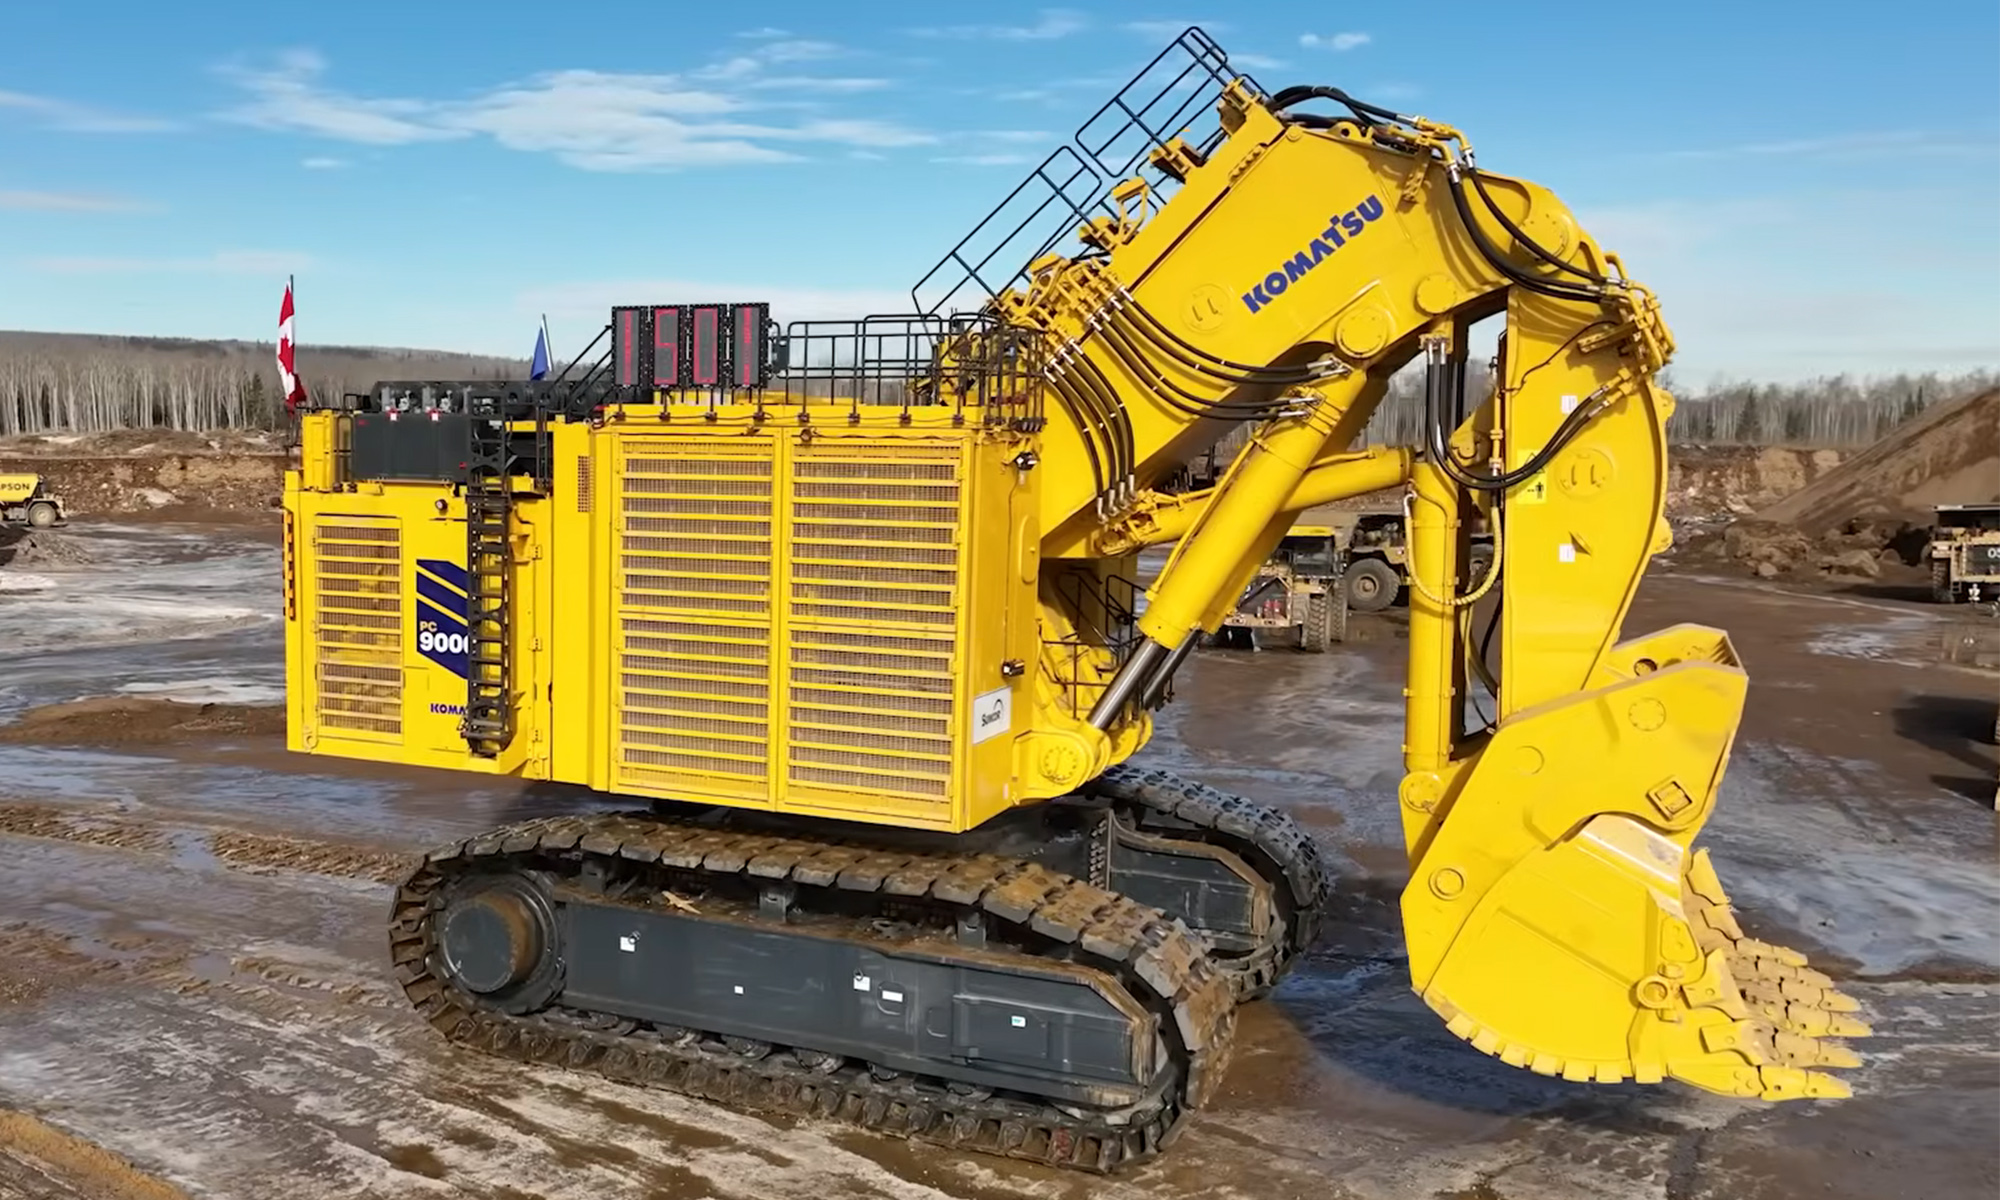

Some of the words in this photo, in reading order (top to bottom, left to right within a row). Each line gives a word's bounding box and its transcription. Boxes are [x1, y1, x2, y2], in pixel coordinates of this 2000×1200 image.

[1241, 195, 1384, 314] KOMATSU
[0, 483, 30, 491] PSON
[419, 621, 438, 632] PC
